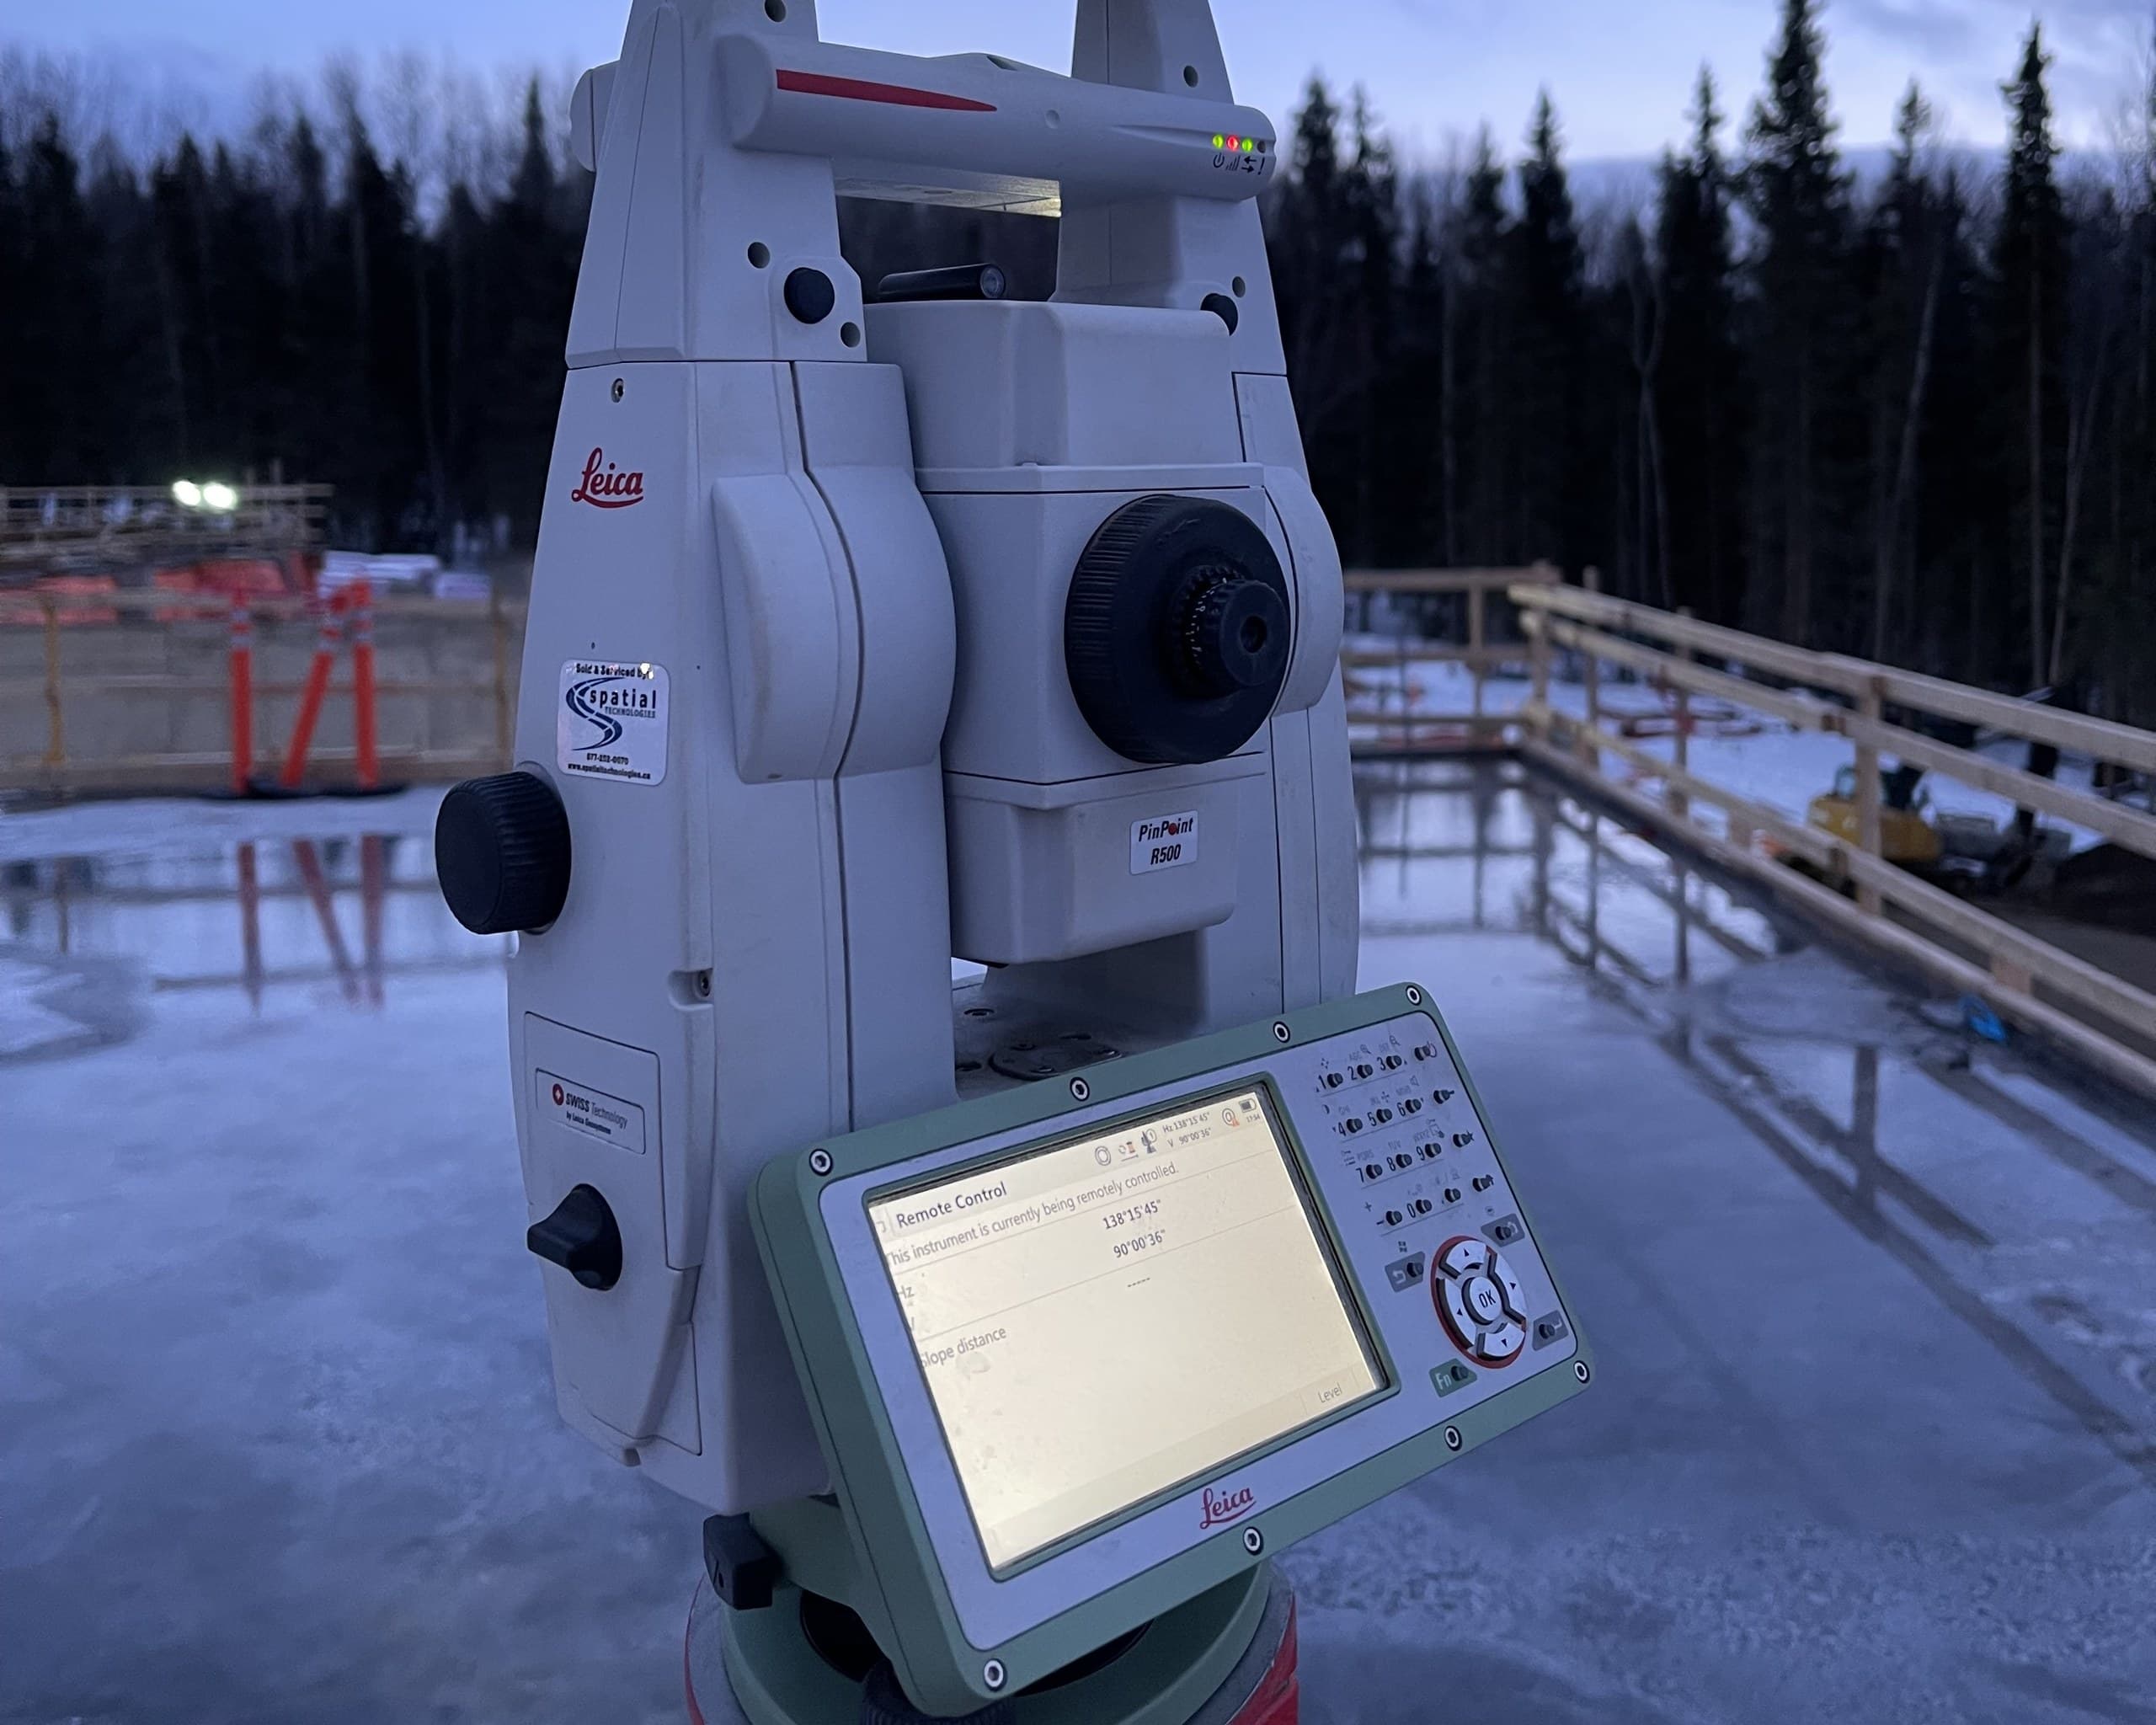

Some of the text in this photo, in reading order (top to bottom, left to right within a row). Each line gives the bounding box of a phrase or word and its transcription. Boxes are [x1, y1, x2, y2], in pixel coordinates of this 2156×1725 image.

[571, 446, 643, 509] Leica
[576, 663, 593, 674] Sold
[590, 688, 656, 709] spatial
[605, 706, 656, 718] TECHNOLOGIES
[1139, 817, 1193, 842] PinPoint
[1150, 844, 1182, 865] R500
[1318, 1056, 1386, 1090] 1 2 3
[566, 1092, 590, 1112] SWISS
[591, 1102, 627, 1130] Technology
[1337, 1102, 1406, 1136] 4 5 6
[1167, 1138, 1174, 1147] V
[1356, 1146, 1426, 1183] 7 8 9
[895, 1181, 1007, 1229] Remote Control
[910, 1227, 979, 1259] instrument
[978, 1223, 990, 1237] is
[991, 1205, 1042, 1233] currently
[1042, 1196, 1075, 1216] being
[1076, 1181, 1123, 1205] remotely
[1125, 1162, 1180, 1188] controlled.
[1406, 1203, 1416, 1218] 0
[1478, 1290, 1497, 1308] OK
[957, 1327, 1007, 1355] distance
[1317, 1381, 1342, 1403] Level
[1435, 1373, 1452, 1391] Fn
[1199, 1487, 1257, 1530] Leica
